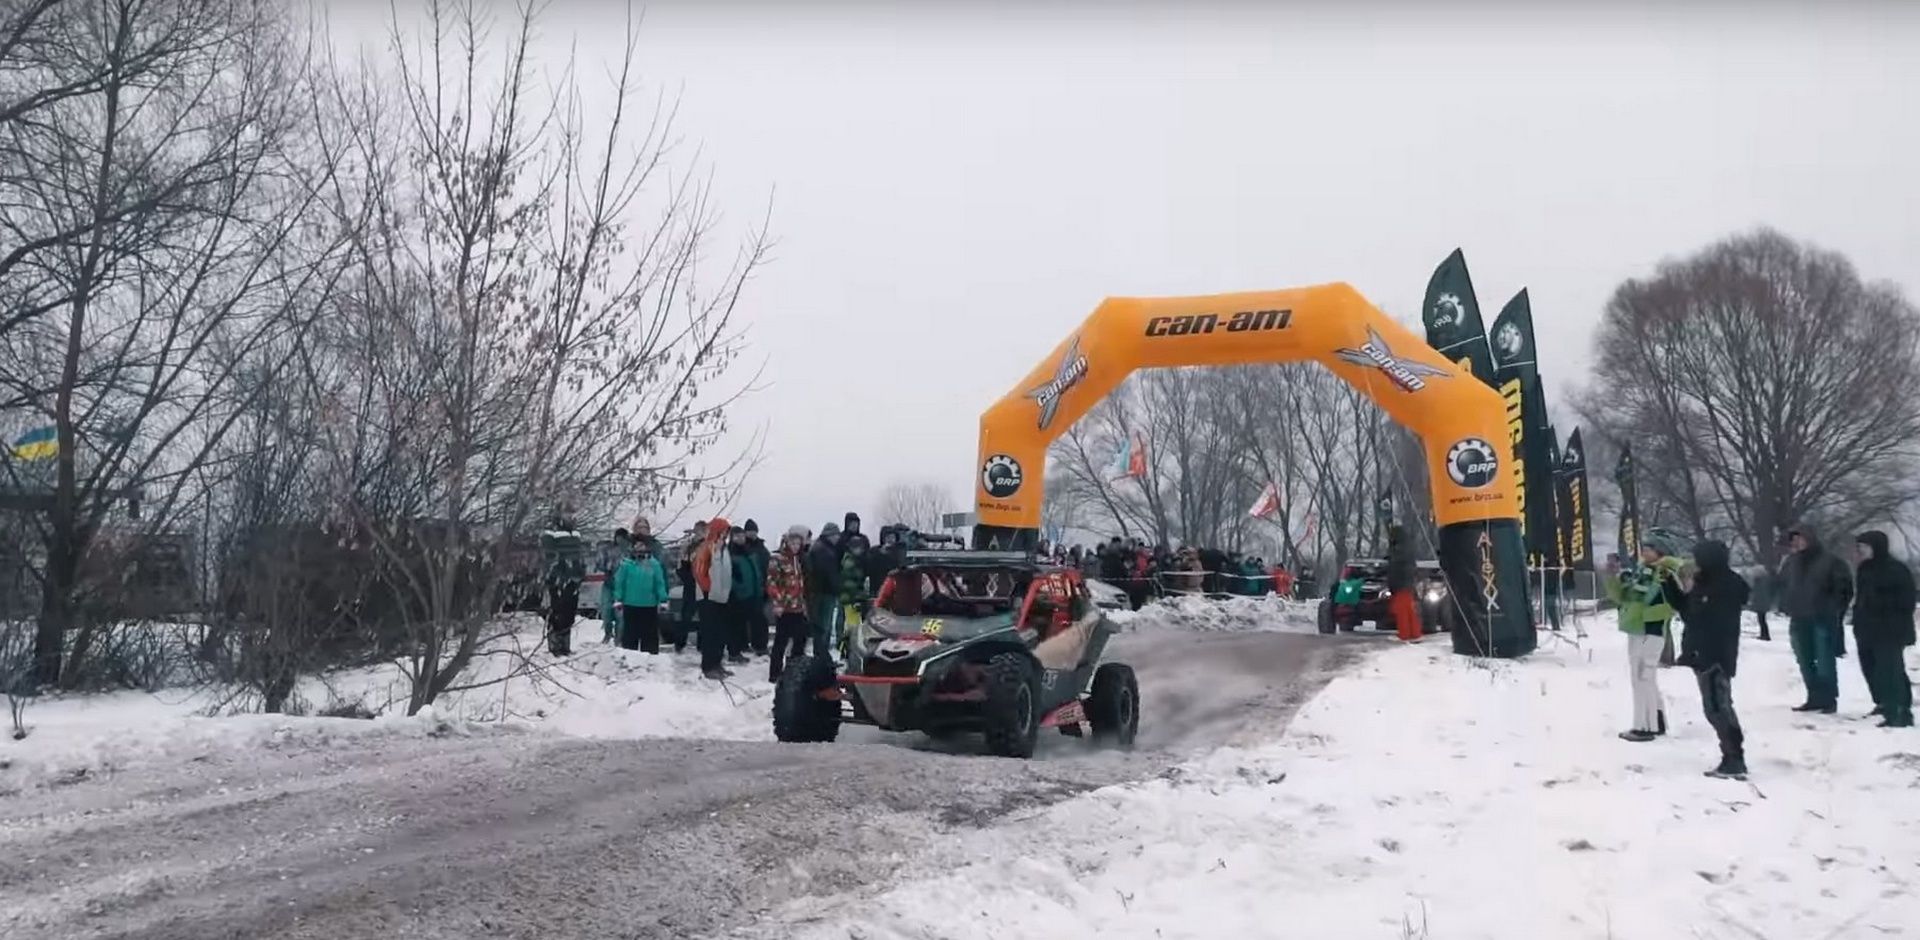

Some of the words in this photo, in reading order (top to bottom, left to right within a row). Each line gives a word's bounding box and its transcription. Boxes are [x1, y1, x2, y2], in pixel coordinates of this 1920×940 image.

[1145, 309, 1292, 337] can-am
[1360, 342, 1426, 392] can-am
[1037, 355, 1088, 408] can-am
[995, 477, 1021, 487] BRP
[1466, 462, 1498, 474] BRP
